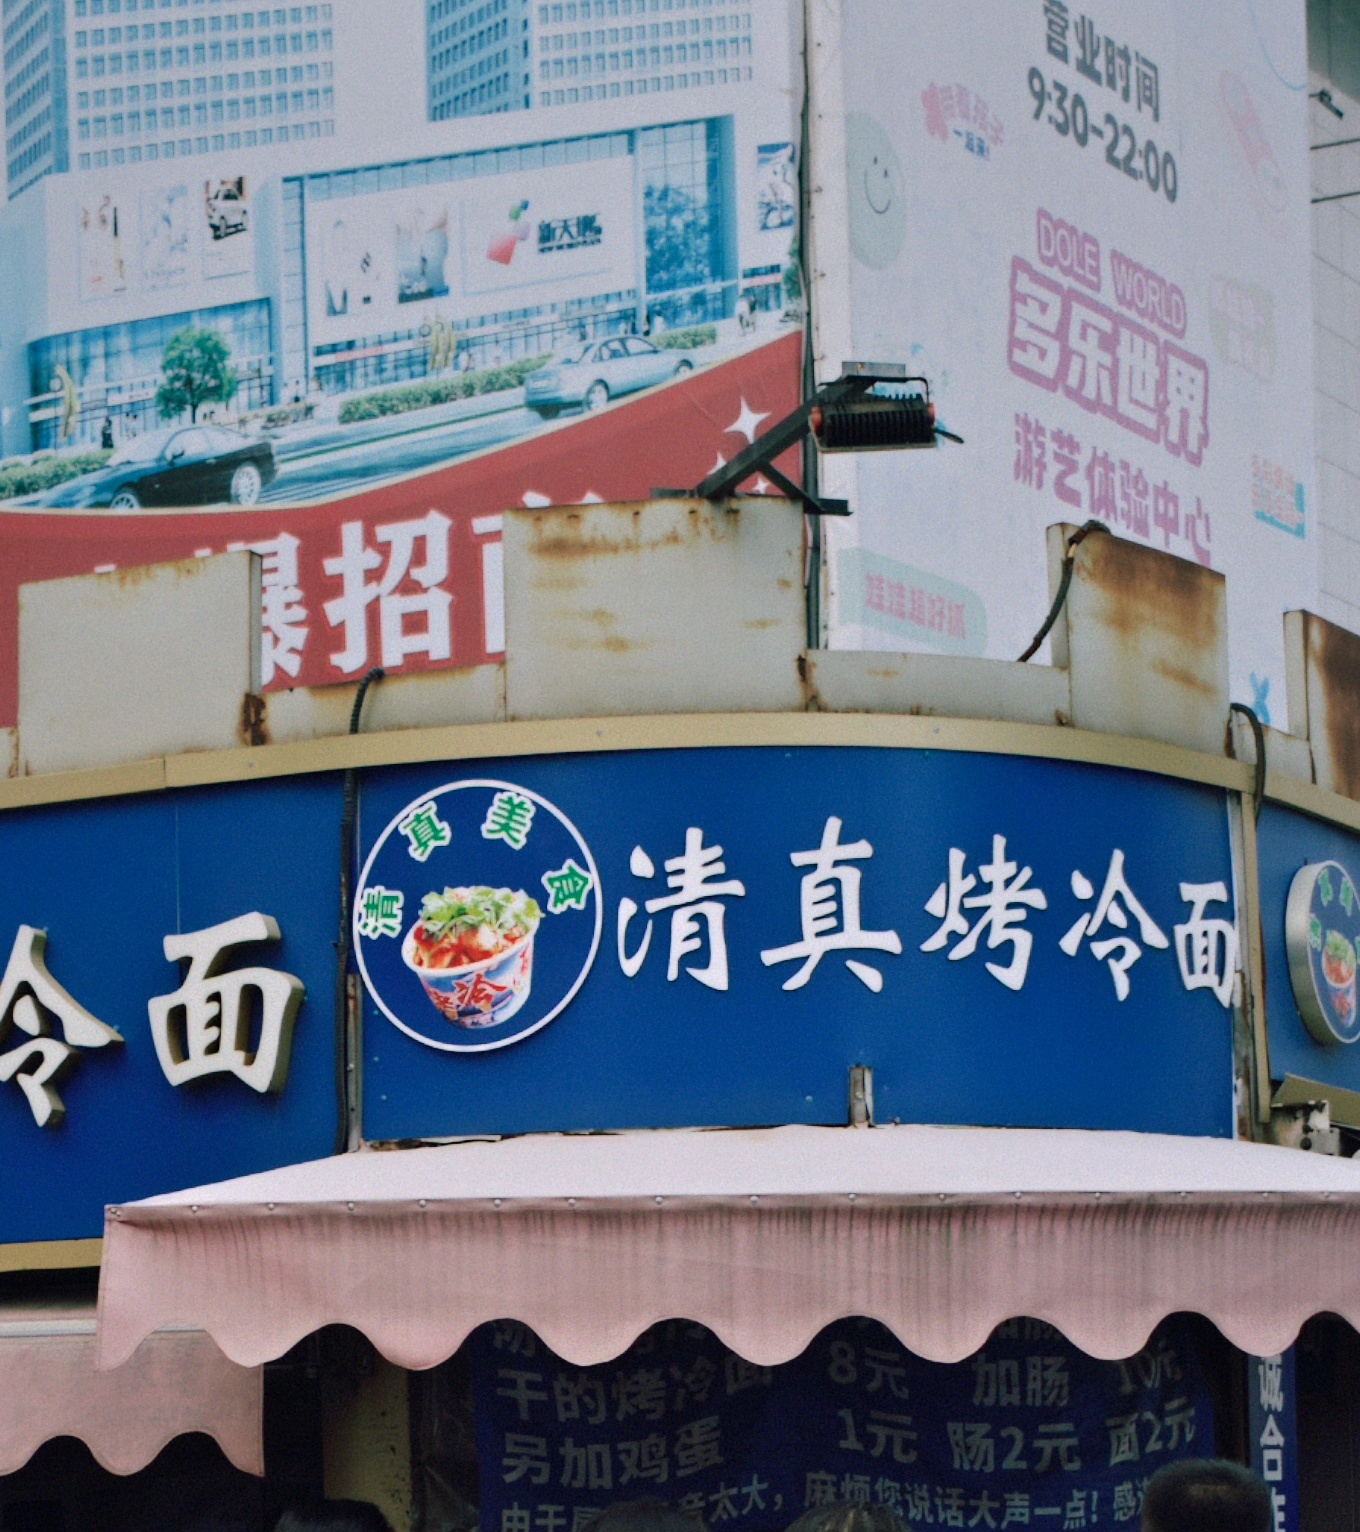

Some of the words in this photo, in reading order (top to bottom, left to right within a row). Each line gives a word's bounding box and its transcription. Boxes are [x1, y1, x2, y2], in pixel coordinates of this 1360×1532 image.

[1041, 2, 1162, 122] 营业时间
[1027, 66, 1179, 203] 9:30-22:00
[1038, 209, 1101, 293] DOLE
[1110, 249, 1187, 339] WORLD
[1008, 256, 1210, 467] 多乐世界
[1014, 412, 1212, 566] 游艺体验中心
[358, 791, 593, 940] 清真美食
[616, 814, 1238, 1006] 清真烤冷面
[495, 1354, 773, 1425] 干的烤冷面
[827, 1340, 910, 1400] 8元
[972, 1353, 1071, 1407] 加肠
[500, 1415, 725, 1491] 另加鸡蛋
[837, 1408, 919, 1465] 1元
[946, 1420, 1083, 1474] 肠2元
[1105, 1396, 1197, 1468] 面2元
